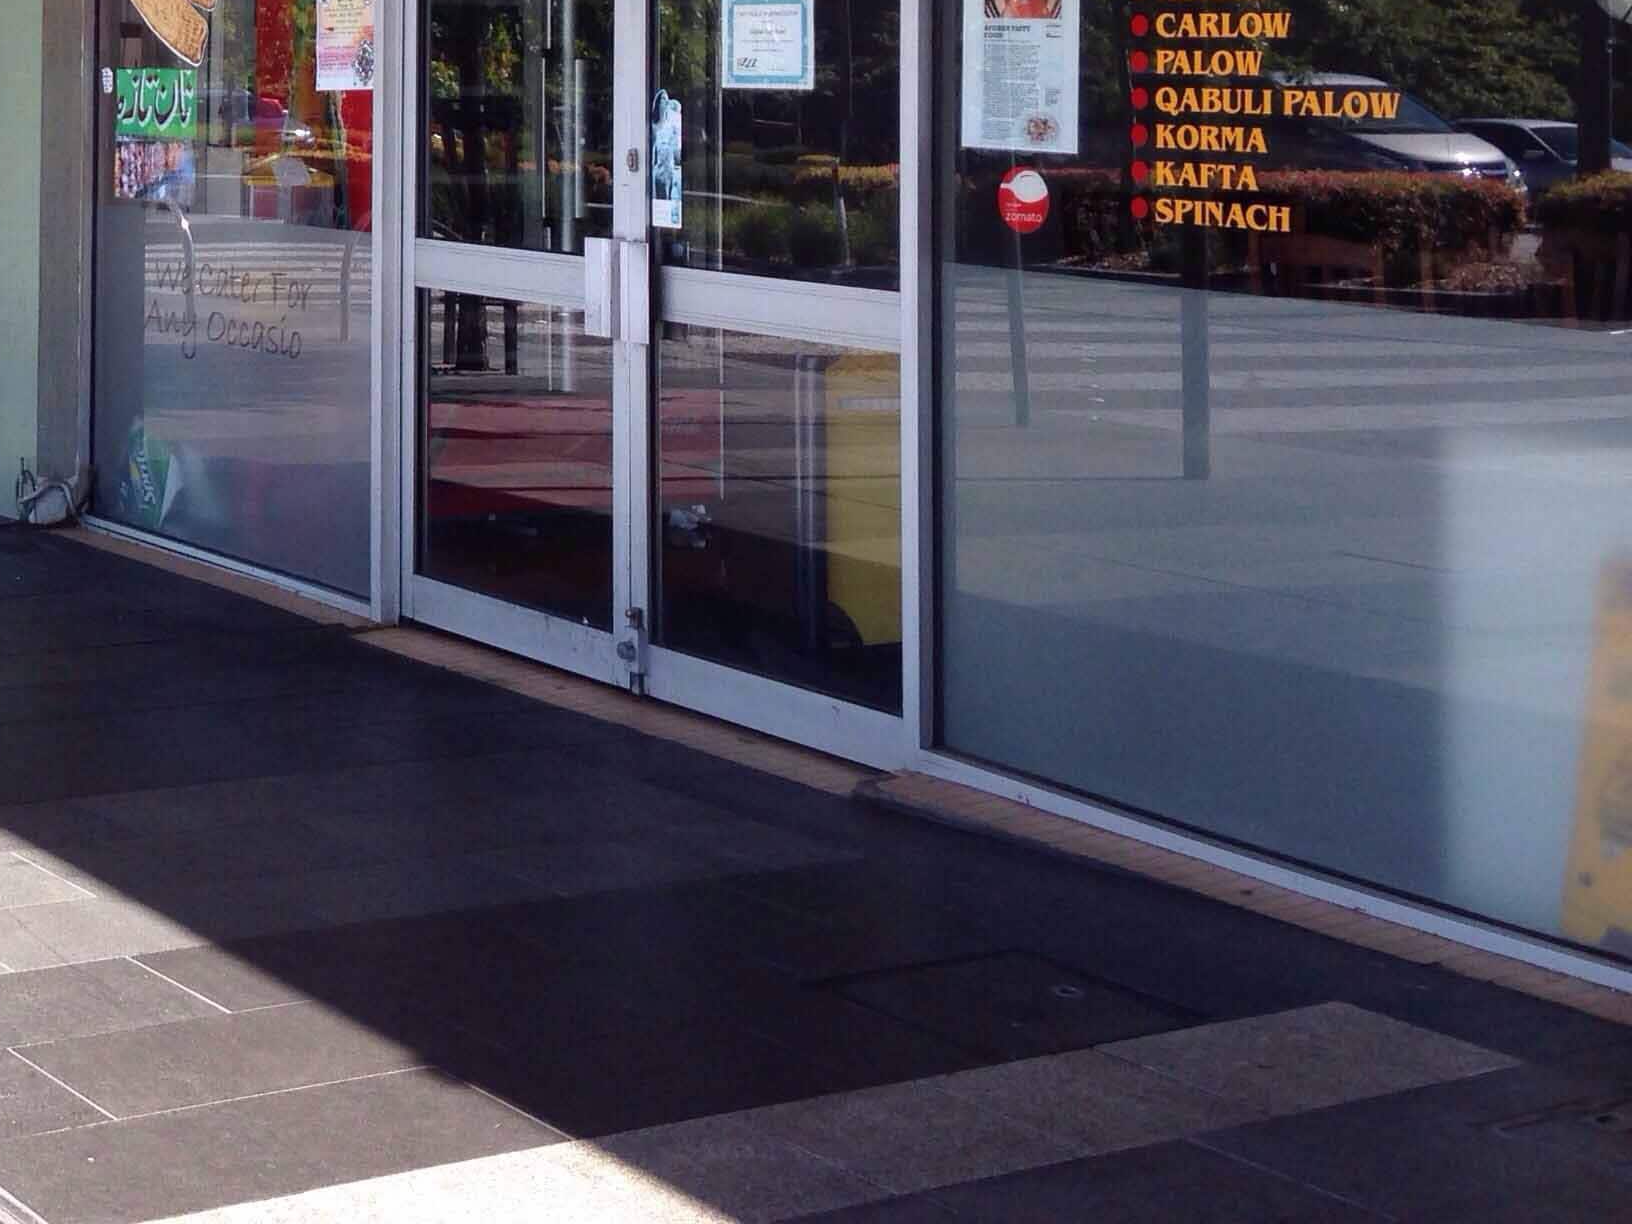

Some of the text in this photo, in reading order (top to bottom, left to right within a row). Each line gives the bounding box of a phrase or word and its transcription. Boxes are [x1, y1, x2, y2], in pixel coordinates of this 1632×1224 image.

[1155, 12, 1292, 39] CARLOW
[1155, 49, 1264, 77] PALOW
[1155, 86, 1401, 119] QABULI PALOW
[1155, 123, 1269, 154] KORMA
[1155, 160, 1260, 192] KAFTA
[1004, 210, 1043, 223] zomato
[1155, 197, 1291, 233] SPINACH
[199, 263, 264, 304] Cater
[271, 272, 313, 312] For
[144, 299, 197, 360] Any
